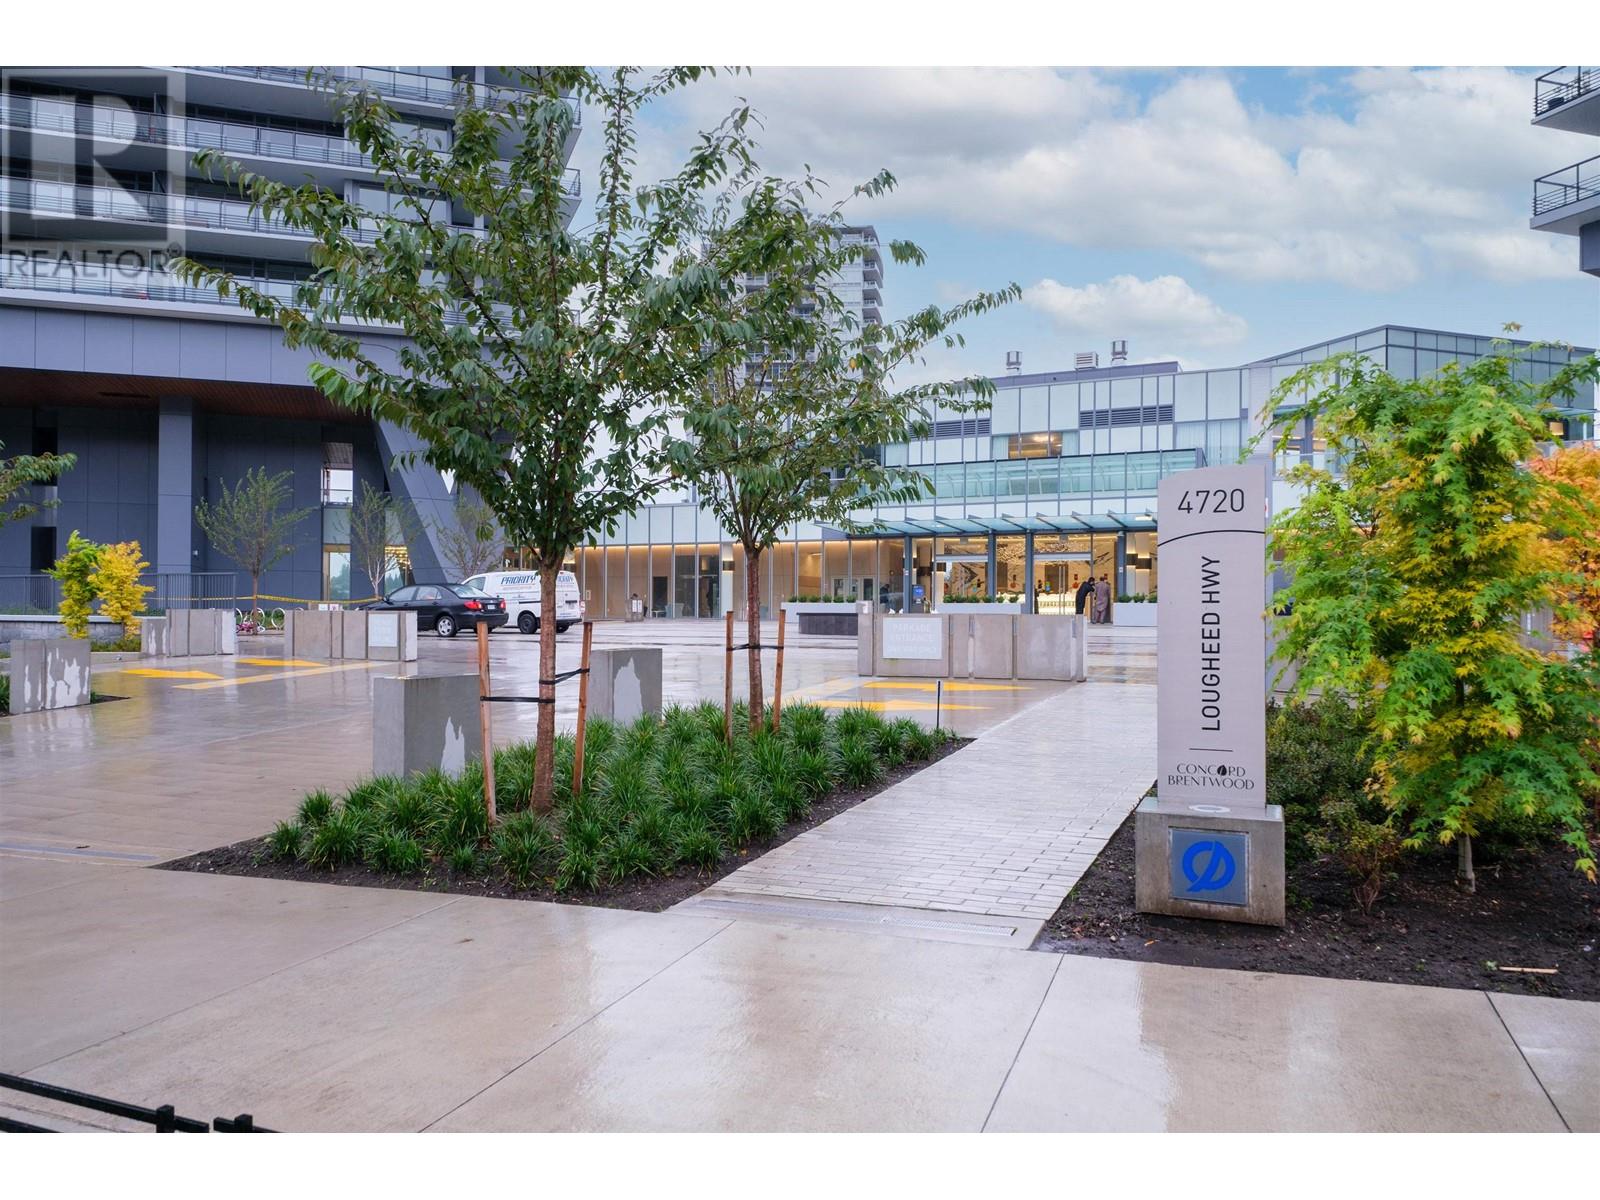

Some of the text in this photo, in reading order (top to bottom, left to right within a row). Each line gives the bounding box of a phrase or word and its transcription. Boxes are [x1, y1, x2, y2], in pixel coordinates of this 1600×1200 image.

[1178, 488, 1245, 514] 4720
[500, 575, 537, 585] PRIORITY
[1201, 555, 1221, 731] LOUGHEED HWY
[1176, 763, 1246, 778] CONCORD
[1167, 775, 1255, 791] BRENTWOOD
